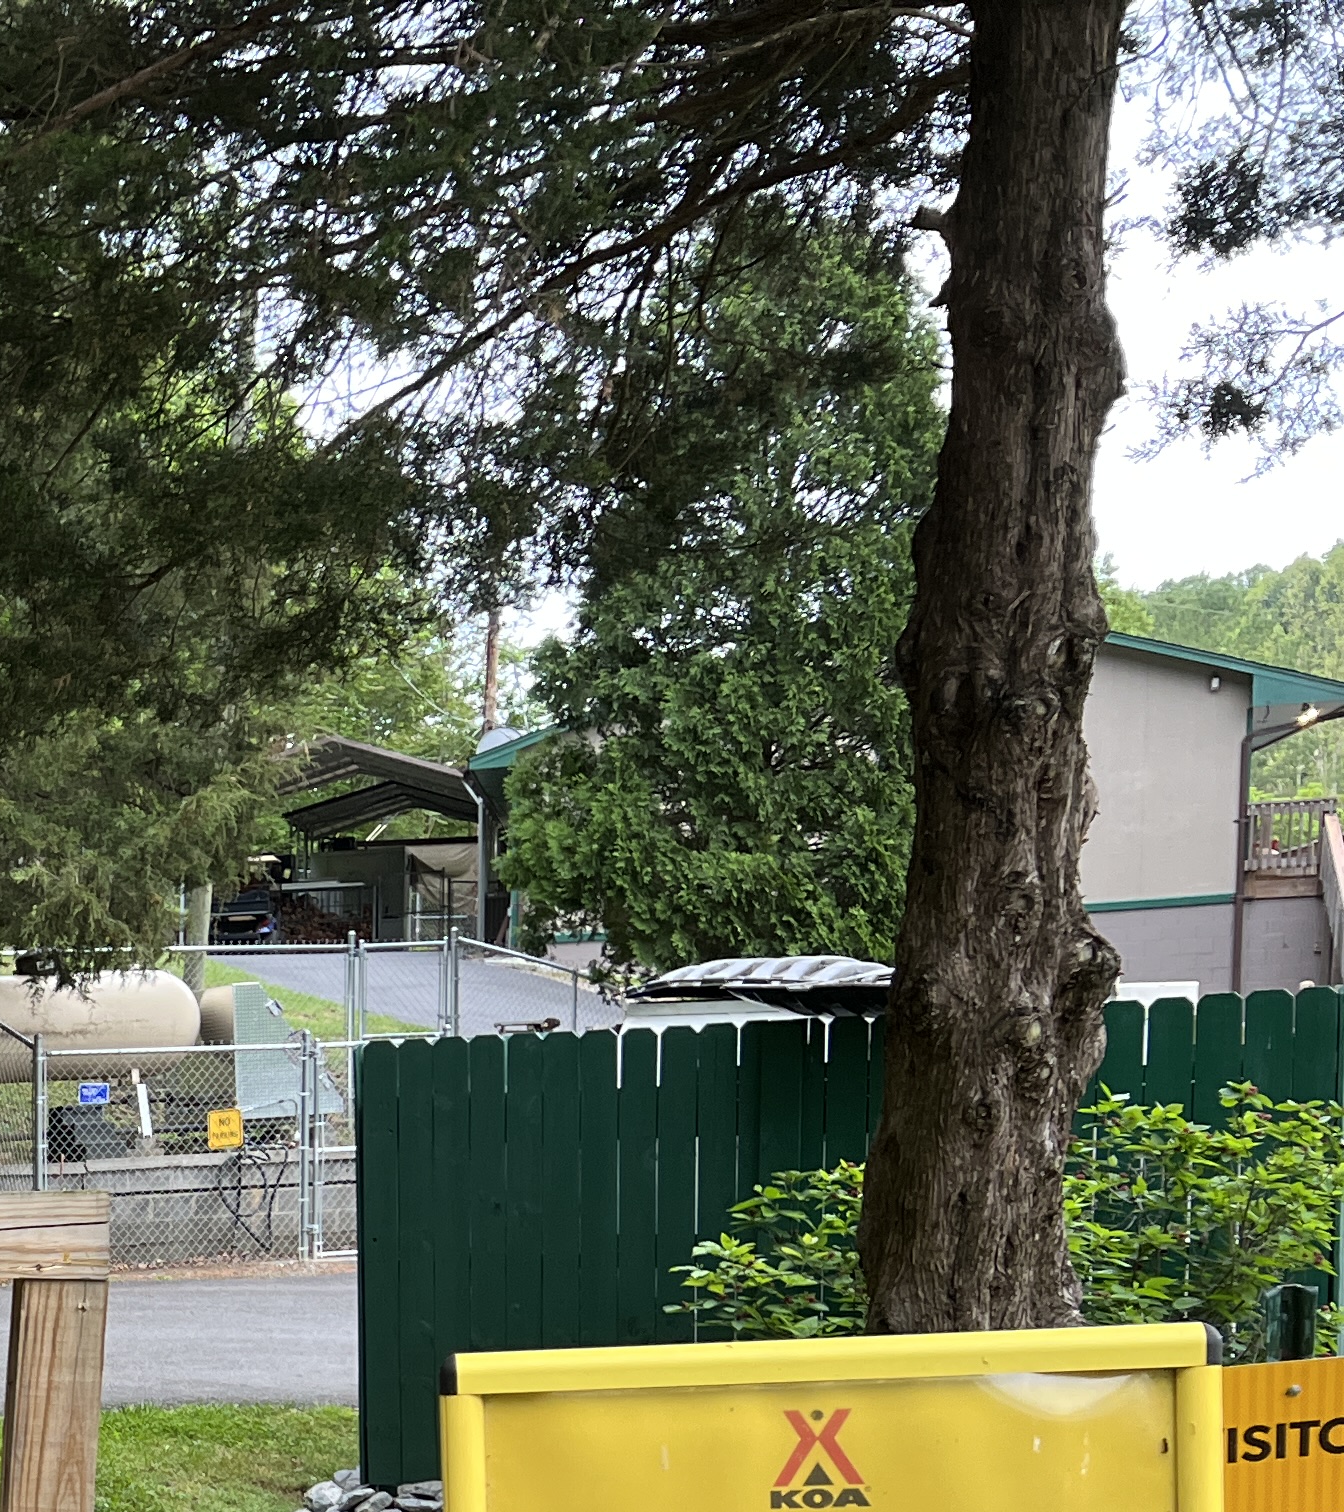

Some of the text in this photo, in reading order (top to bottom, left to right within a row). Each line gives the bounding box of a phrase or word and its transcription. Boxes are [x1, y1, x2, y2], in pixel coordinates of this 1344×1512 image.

[218, 1117, 231, 1127] NO
[1224, 1417, 1344, 1464] ISITO
[770, 1488, 871, 1509] KOA
